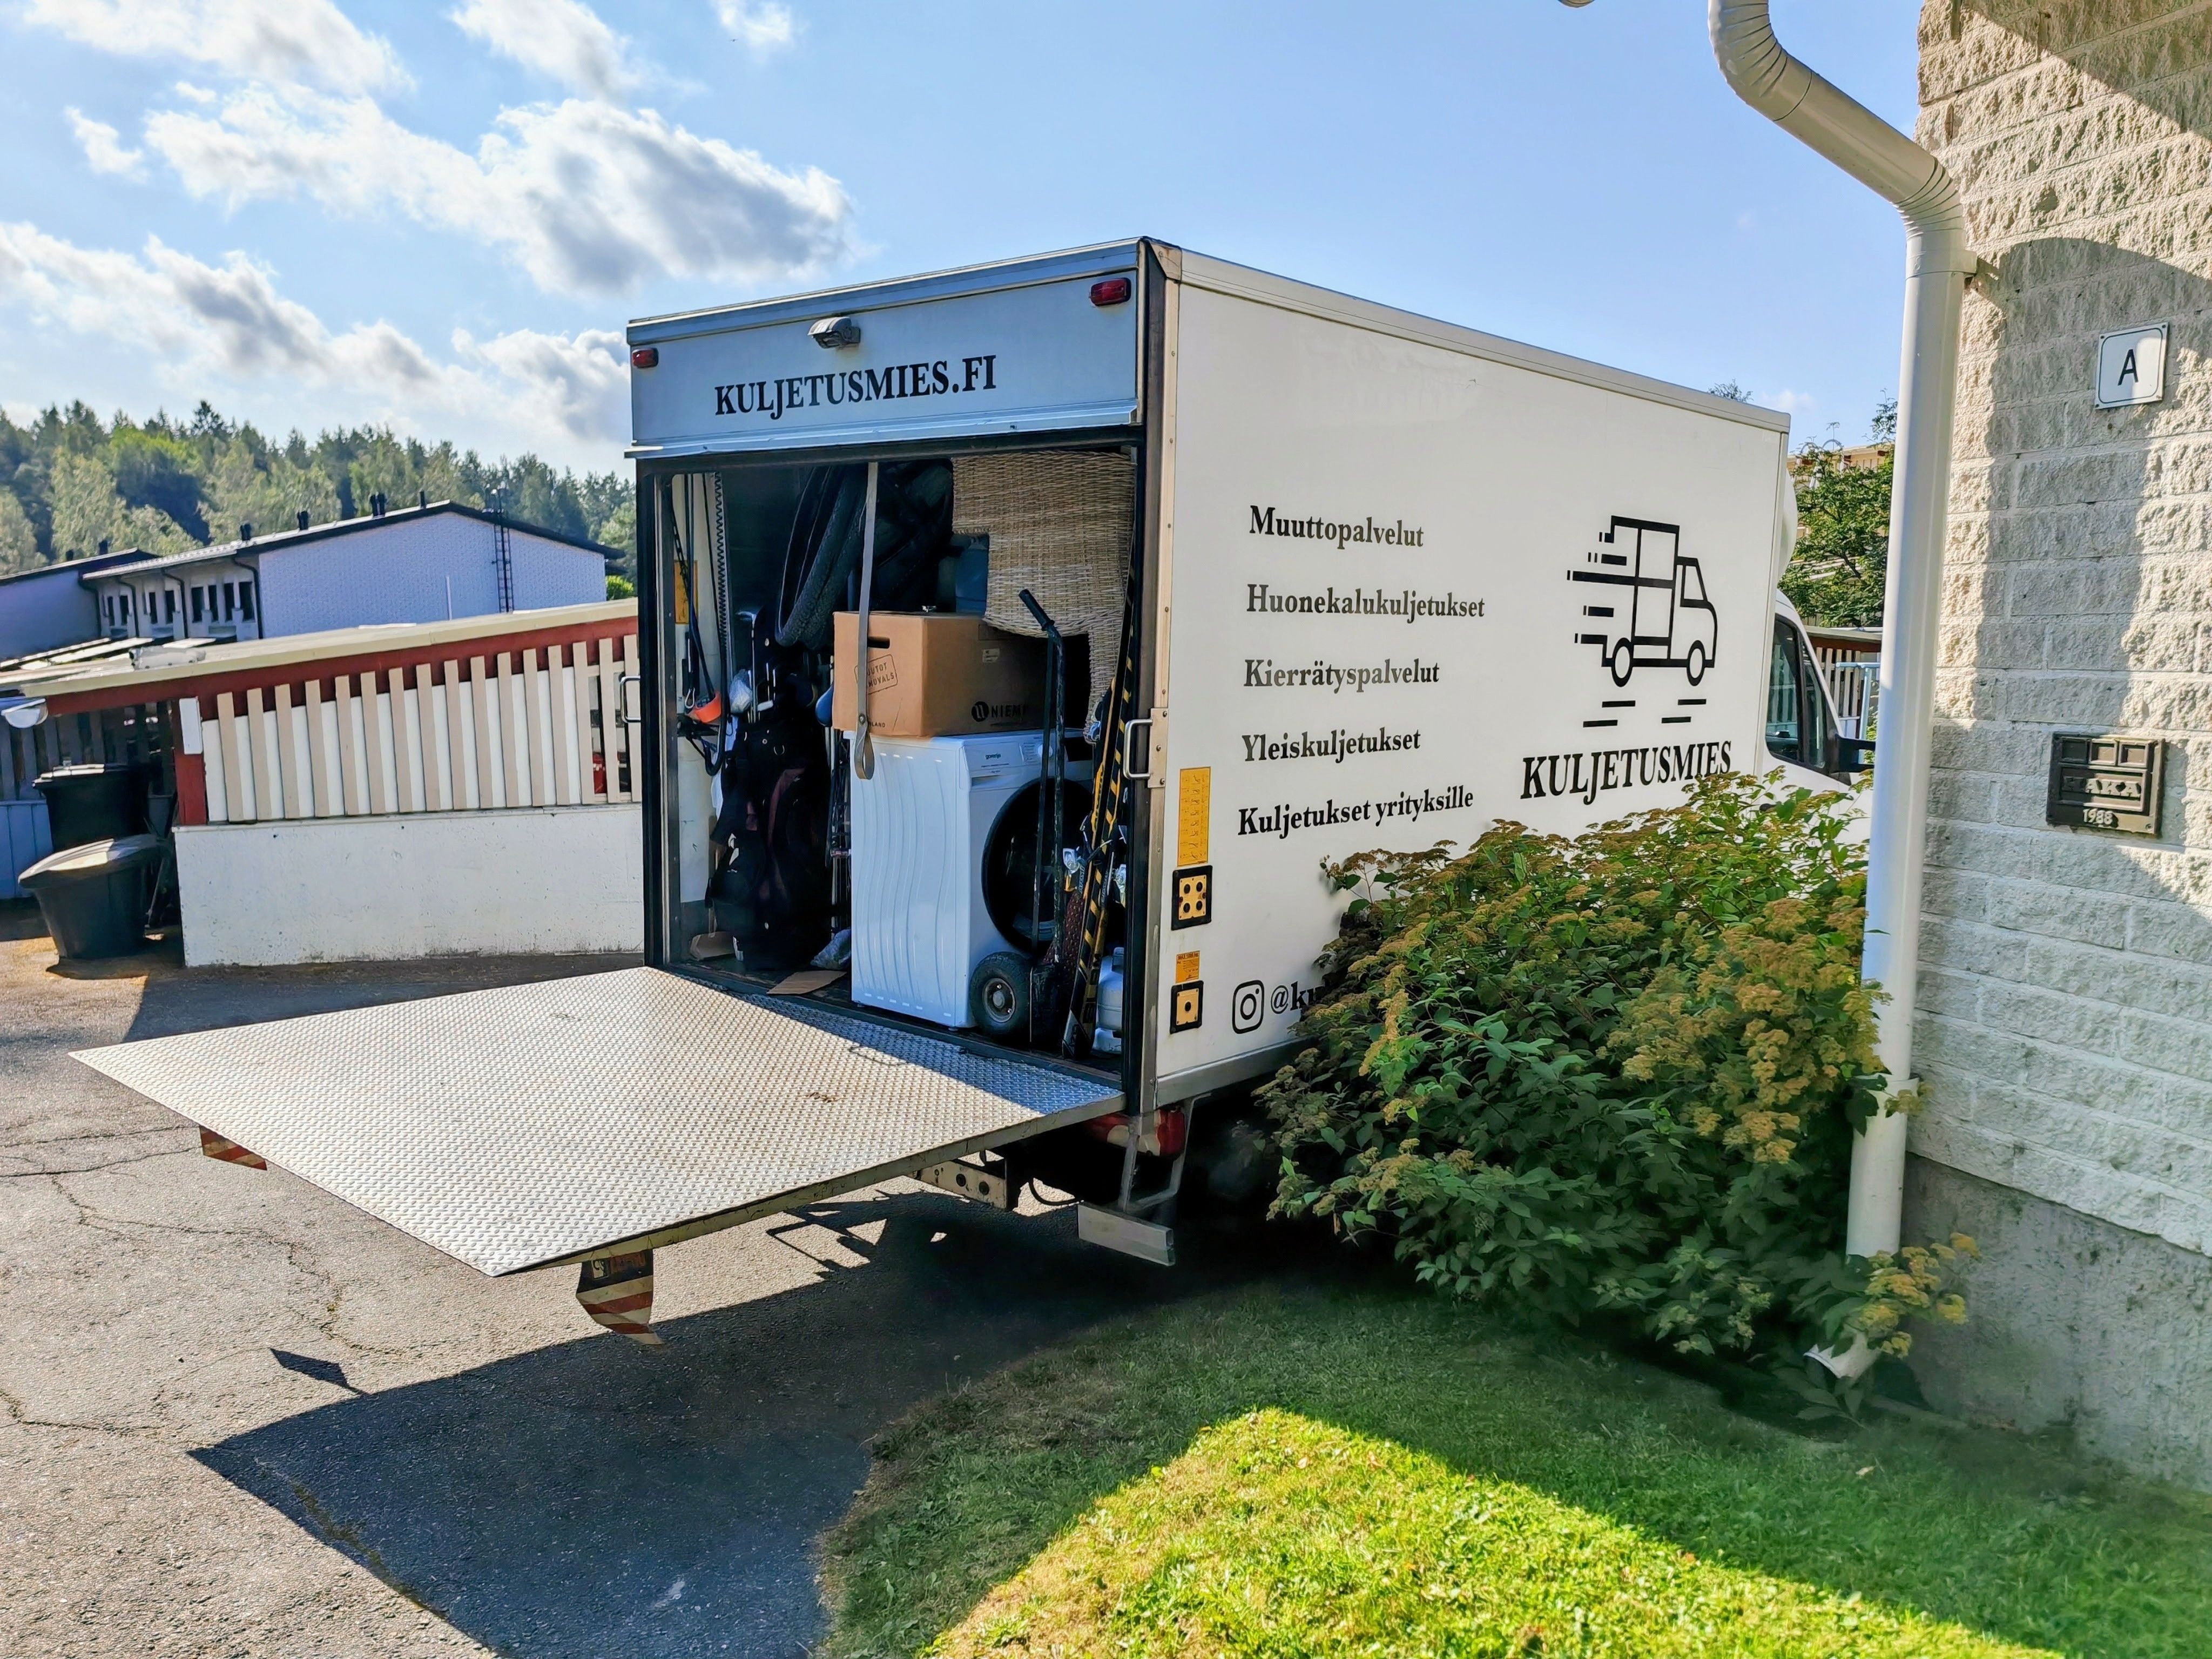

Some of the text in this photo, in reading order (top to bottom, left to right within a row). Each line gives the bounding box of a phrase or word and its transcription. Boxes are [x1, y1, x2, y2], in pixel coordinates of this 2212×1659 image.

[2117, 348, 2139, 387] A
[714, 355, 997, 420] KULJETUSMIES.FI
[1249, 505, 1424, 550] Muuttopalvelut
[1246, 584, 1485, 624] Huonekalukuljetukset
[868, 672, 894, 687] MOVALS
[1243, 658, 1440, 694] Kierrätyspalvelut
[1242, 727, 1421, 764] Yleiskuljetukset
[1520, 740, 1731, 805] KULJETUSMIES
[1237, 785, 1474, 839] Kuljetukset yrityksille
[2083, 808, 2113, 825] 1988
